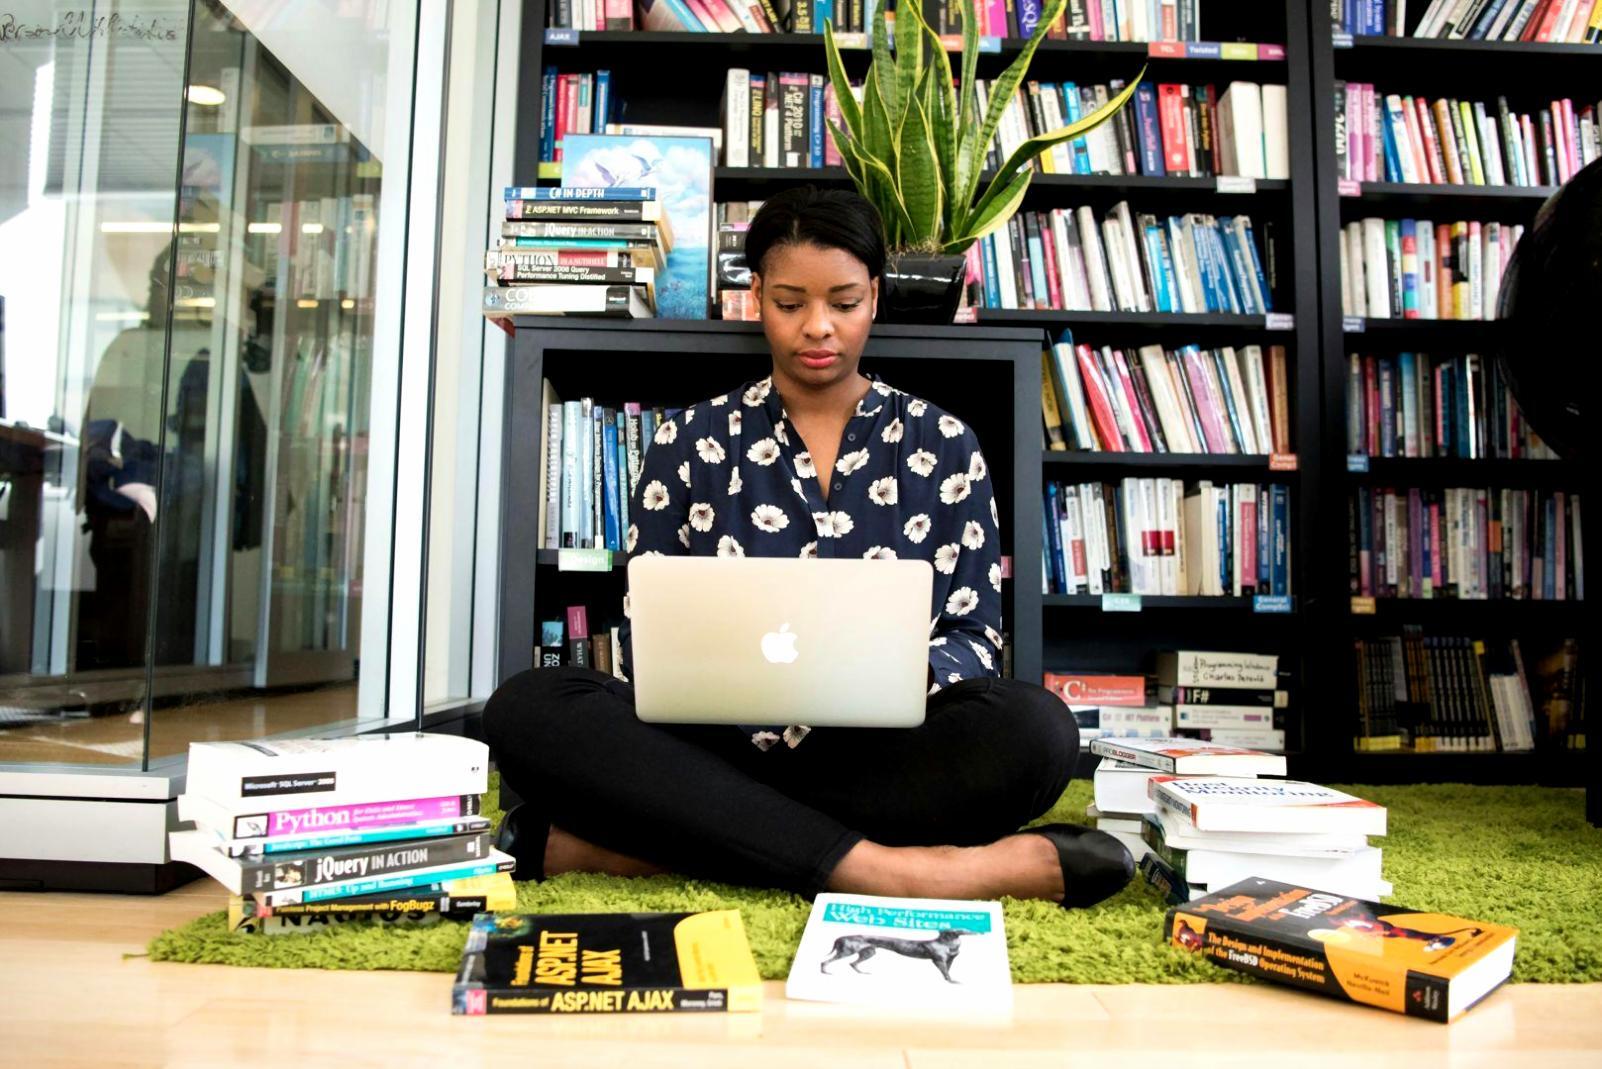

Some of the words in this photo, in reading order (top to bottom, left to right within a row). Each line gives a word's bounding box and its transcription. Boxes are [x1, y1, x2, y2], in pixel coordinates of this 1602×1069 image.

[1022, 0, 1038, 33] SQL
[549, 188, 560, 199] C#
[563, 188, 574, 198] IN
[575, 188, 605, 198] DEPTH
[562, 205, 578, 214] MVC
[579, 206, 619, 215] Framework
[544, 223, 576, 237] jQuery
[504, 254, 556, 266] PYTHON
[517, 264, 531, 272] SQL
[531, 265, 552, 273] Server
[570, 266, 590, 275] Query
[558, 272, 579, 281] Tuning
[580, 273, 606, 281] Distilled
[576, 642, 584, 665] WHAT
[1203, 671, 1235, 681] Charles
[1193, 689, 1209, 703] F#
[275, 808, 350, 834] Python
[315, 855, 368, 882] jQuery
[371, 855, 385, 870] IN
[387, 849, 428, 868] ACTION
[330, 903, 373, 912] Management
[390, 900, 435, 912] FogBugz
[830, 903, 871, 915] High
[878, 907, 986, 920] Performance
[830, 911, 886, 925] Web
[893, 916, 951, 930] Sites
[534, 930, 578, 986] ASP.NET
[1208, 932, 1222, 945] The
[1222, 935, 1247, 952] Design
[1249, 944, 1262, 955] and
[1263, 945, 1325, 971] Implementation
[581, 949, 622, 986] AJAX
[1216, 947, 1227, 958] the
[1228, 949, 1258, 967] FreeBSD
[1259, 956, 1297, 978] Operating
[1298, 966, 1325, 984] System
[492, 996, 538, 1007] Foundations
[540, 996, 549, 1007] of
[550, 990, 625, 1012] ASP.NET
[627, 990, 674, 1011] AJAX
